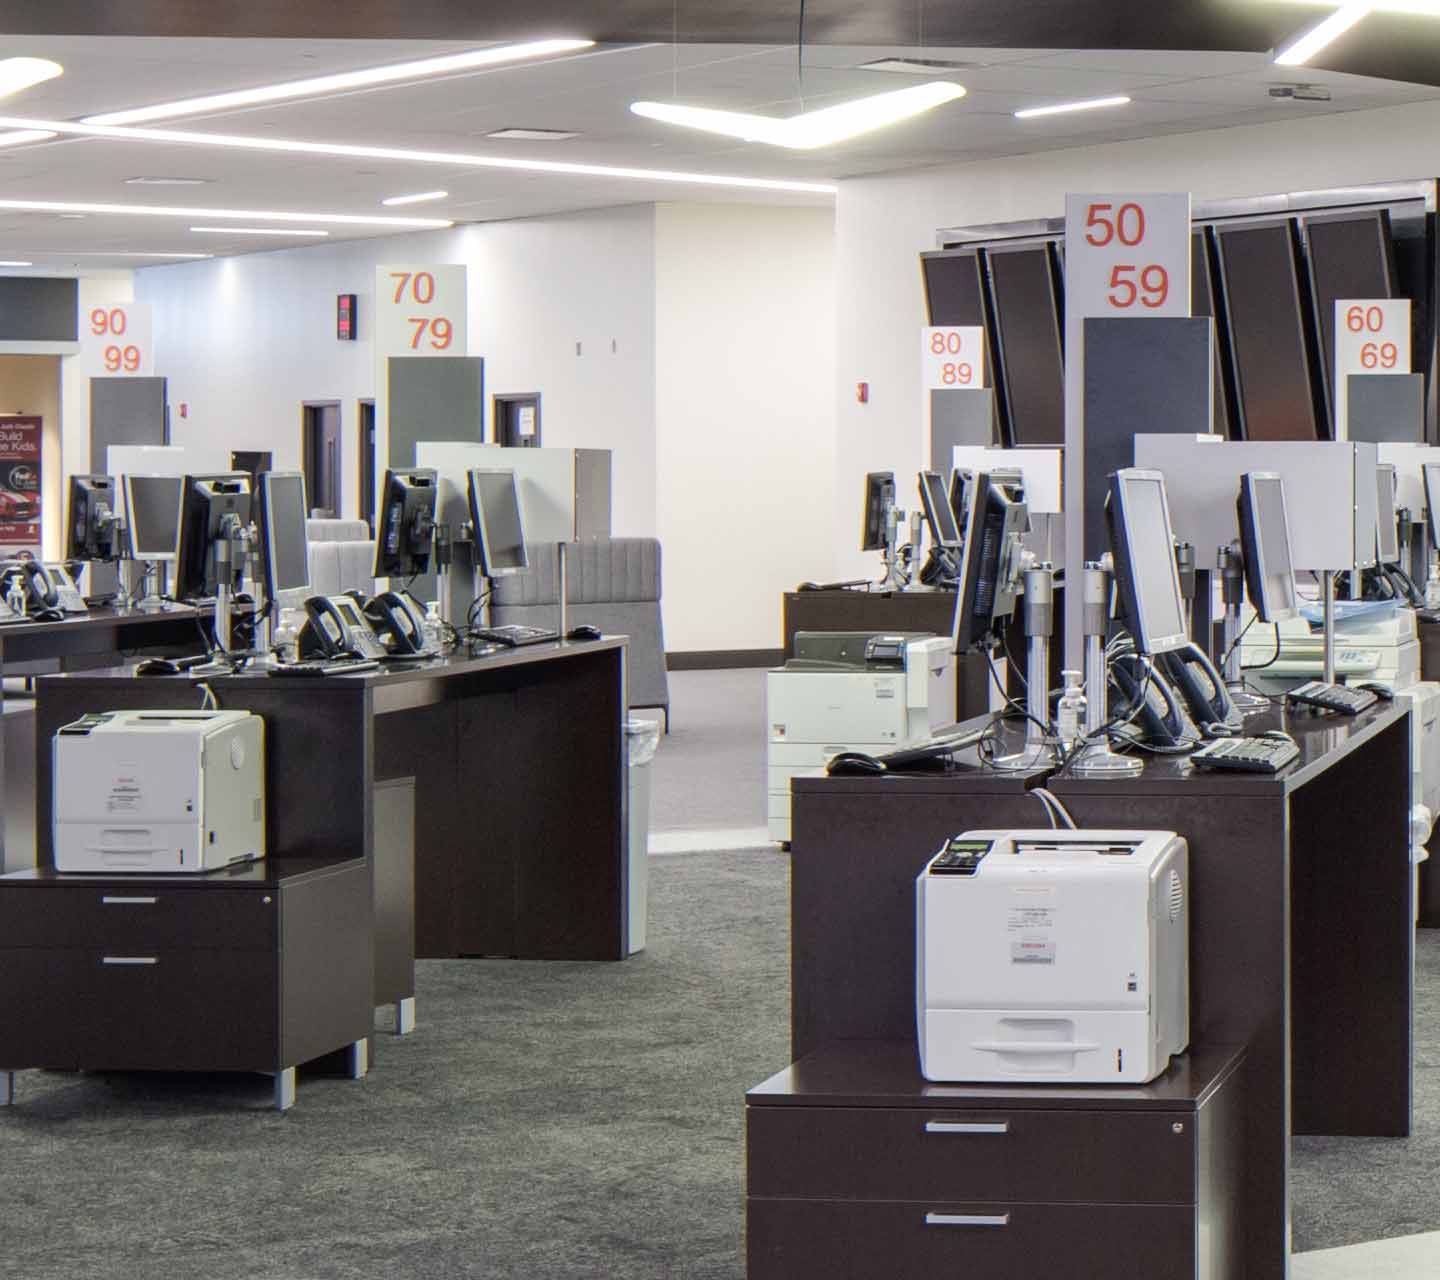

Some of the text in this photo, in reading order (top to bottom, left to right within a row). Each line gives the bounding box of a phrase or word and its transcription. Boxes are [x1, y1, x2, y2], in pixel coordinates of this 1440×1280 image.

[1084, 202, 1146, 247] 50
[389, 271, 436, 305] 70
[1107, 264, 1169, 308] 59
[89, 307, 127, 336] 90
[1345, 304, 1384, 333] 60
[407, 317, 453, 351] 79
[930, 331, 962, 355] 80
[102, 344, 141, 373] 99
[1359, 341, 1398, 369] 69
[942, 363, 972, 385] 89
